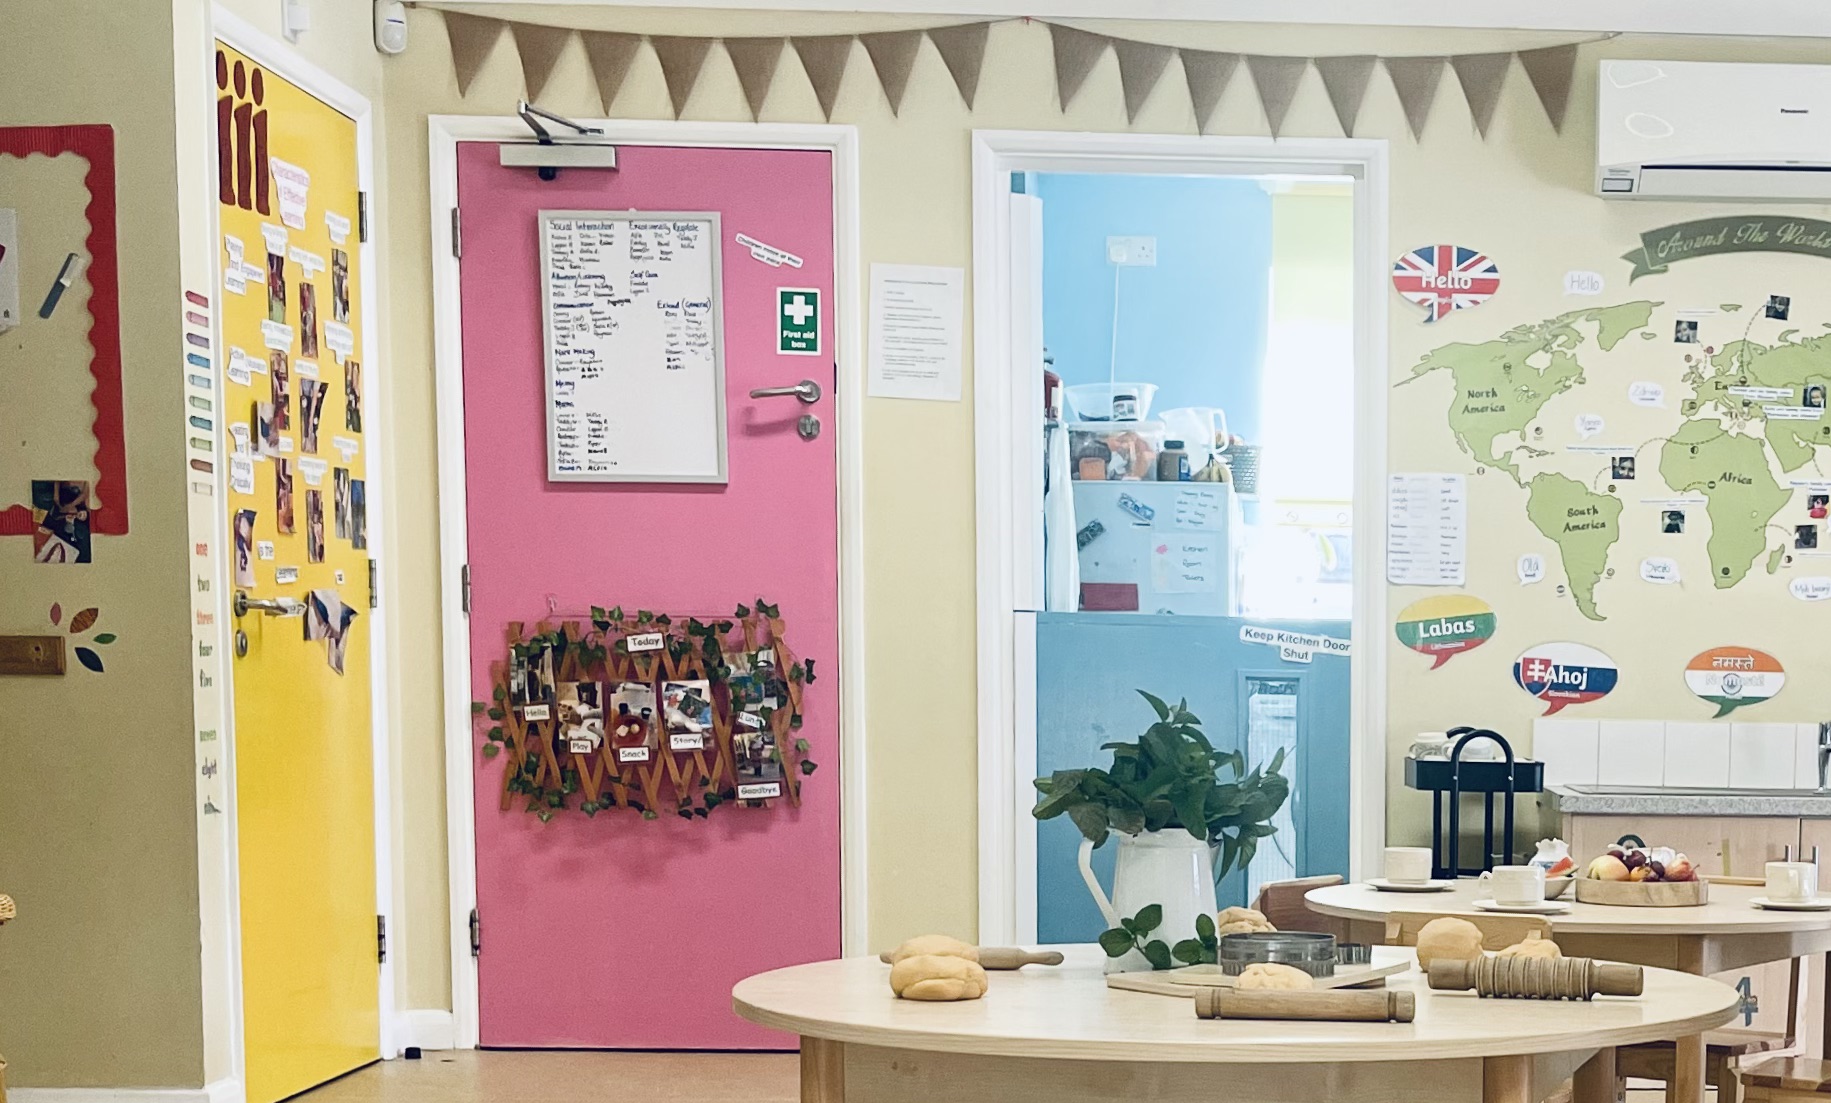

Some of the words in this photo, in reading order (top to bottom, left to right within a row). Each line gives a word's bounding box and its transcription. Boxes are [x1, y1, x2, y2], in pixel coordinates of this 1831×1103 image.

[1657, 227, 1728, 258] Around
[1733, 223, 1769, 245] The
[1421, 271, 1473, 291] Hello
[1570, 273, 1600, 291] Hello
[783, 330, 801, 338] First
[803, 331, 815, 340] aid
[1467, 387, 1498, 399] North
[1461, 403, 1506, 415] America
[1719, 472, 1753, 485] Africa
[1567, 506, 1599, 517] South
[1563, 522, 1607, 533] America
[198, 574, 210, 592] two
[196, 610, 215, 626] three
[1418, 618, 1476, 638] Labas
[630, 636, 662, 647] Today
[1245, 628, 1274, 643] Keep
[1277, 633, 1320, 647] Kitchen
[1323, 639, 1351, 651] Door
[1283, 648, 1309, 660] Shut
[1543, 666, 1589, 689] Ahoj
[525, 708, 547, 718] Hello
[572, 741, 591, 753] Play
[622, 749, 647, 759] Snack
[740, 785, 778, 796] Goodbye
[1736, 977, 1758, 1027] 4
